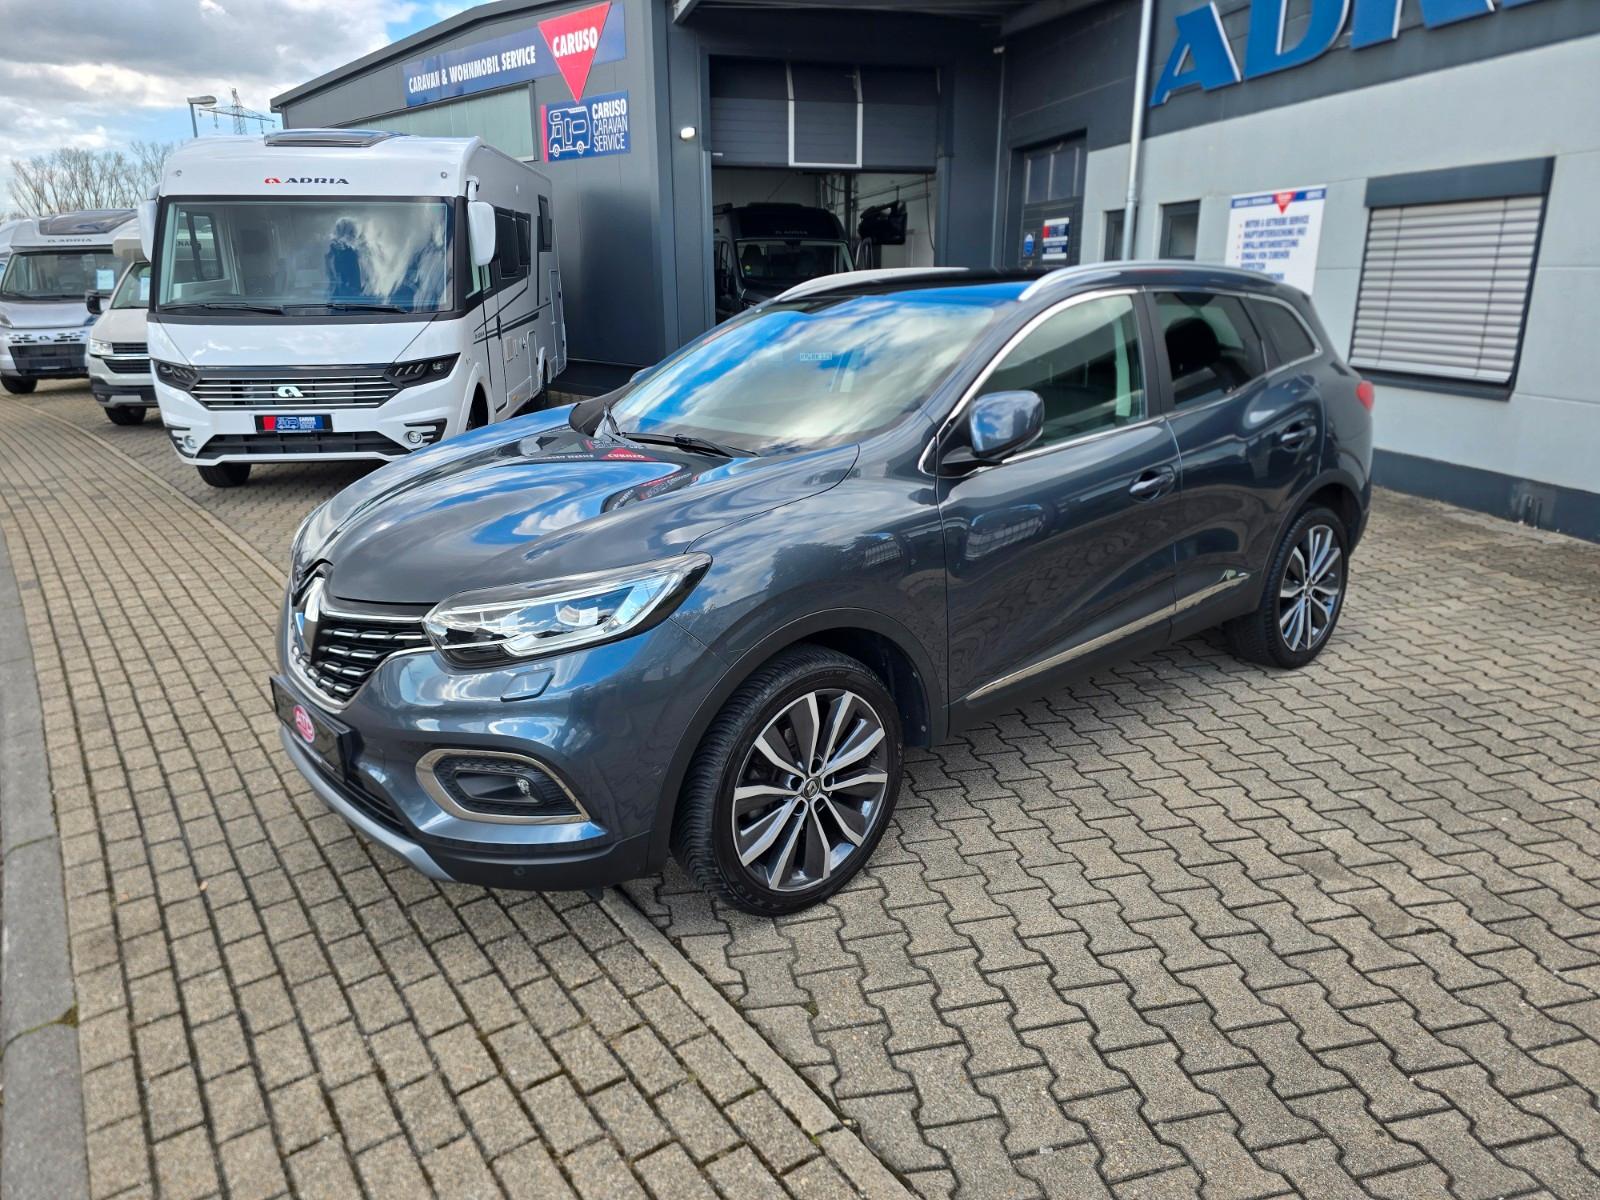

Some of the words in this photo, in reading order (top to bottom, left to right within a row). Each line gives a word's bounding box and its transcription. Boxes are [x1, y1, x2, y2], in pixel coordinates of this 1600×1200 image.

[553, 26, 598, 58] CARUSO
[408, 71, 440, 94] CARAVAN
[441, 69, 448, 85] &
[449, 55, 500, 83] WOHNMOBIL
[501, 45, 536, 71] SERVICE
[592, 98, 627, 119] CARUSO
[592, 115, 628, 136] CARAVAN
[593, 133, 625, 152] SERVICE
[285, 177, 350, 185] ADRIA
